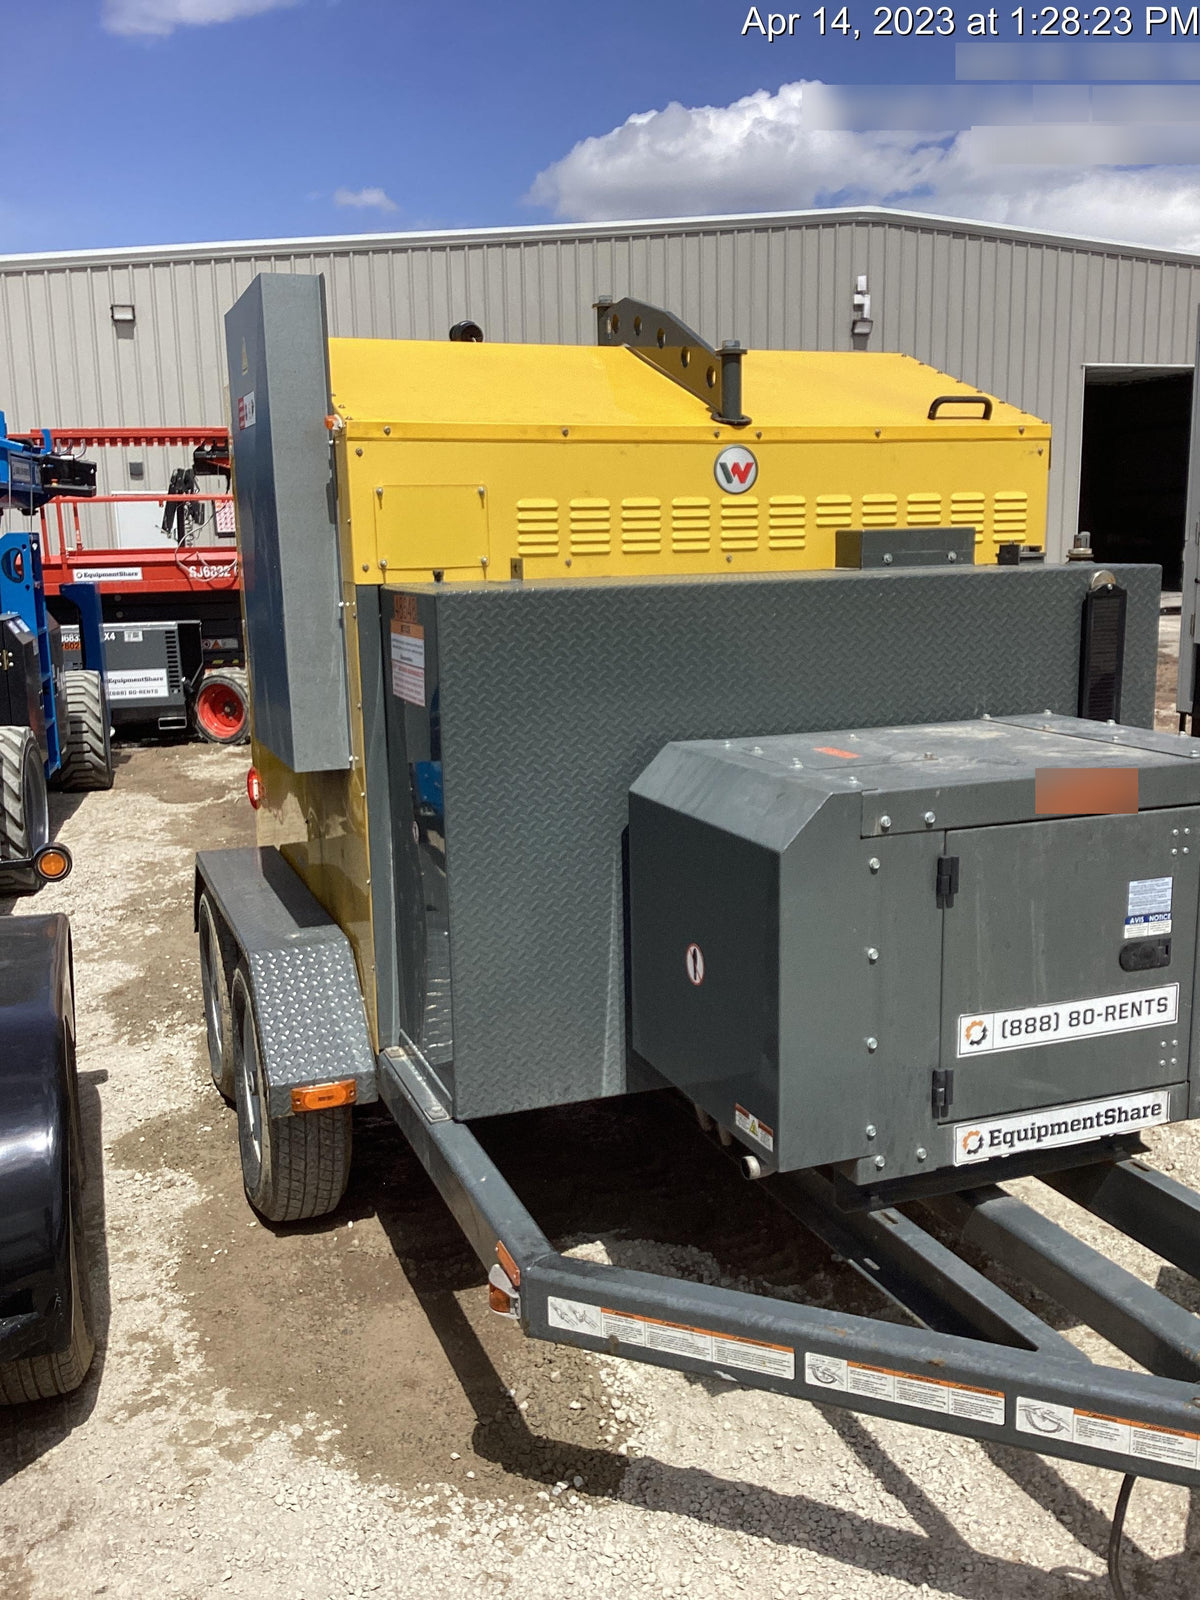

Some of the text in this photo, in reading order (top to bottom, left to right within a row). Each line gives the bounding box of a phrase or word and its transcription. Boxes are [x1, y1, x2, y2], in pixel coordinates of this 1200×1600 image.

[83, 571, 139, 579] EquipmentShare
[108, 676, 164, 684] EquipmentShare
[1002, 997, 1168, 1038] (888) 80-RENTS
[988, 1102, 1162, 1147] EquipmentShare
